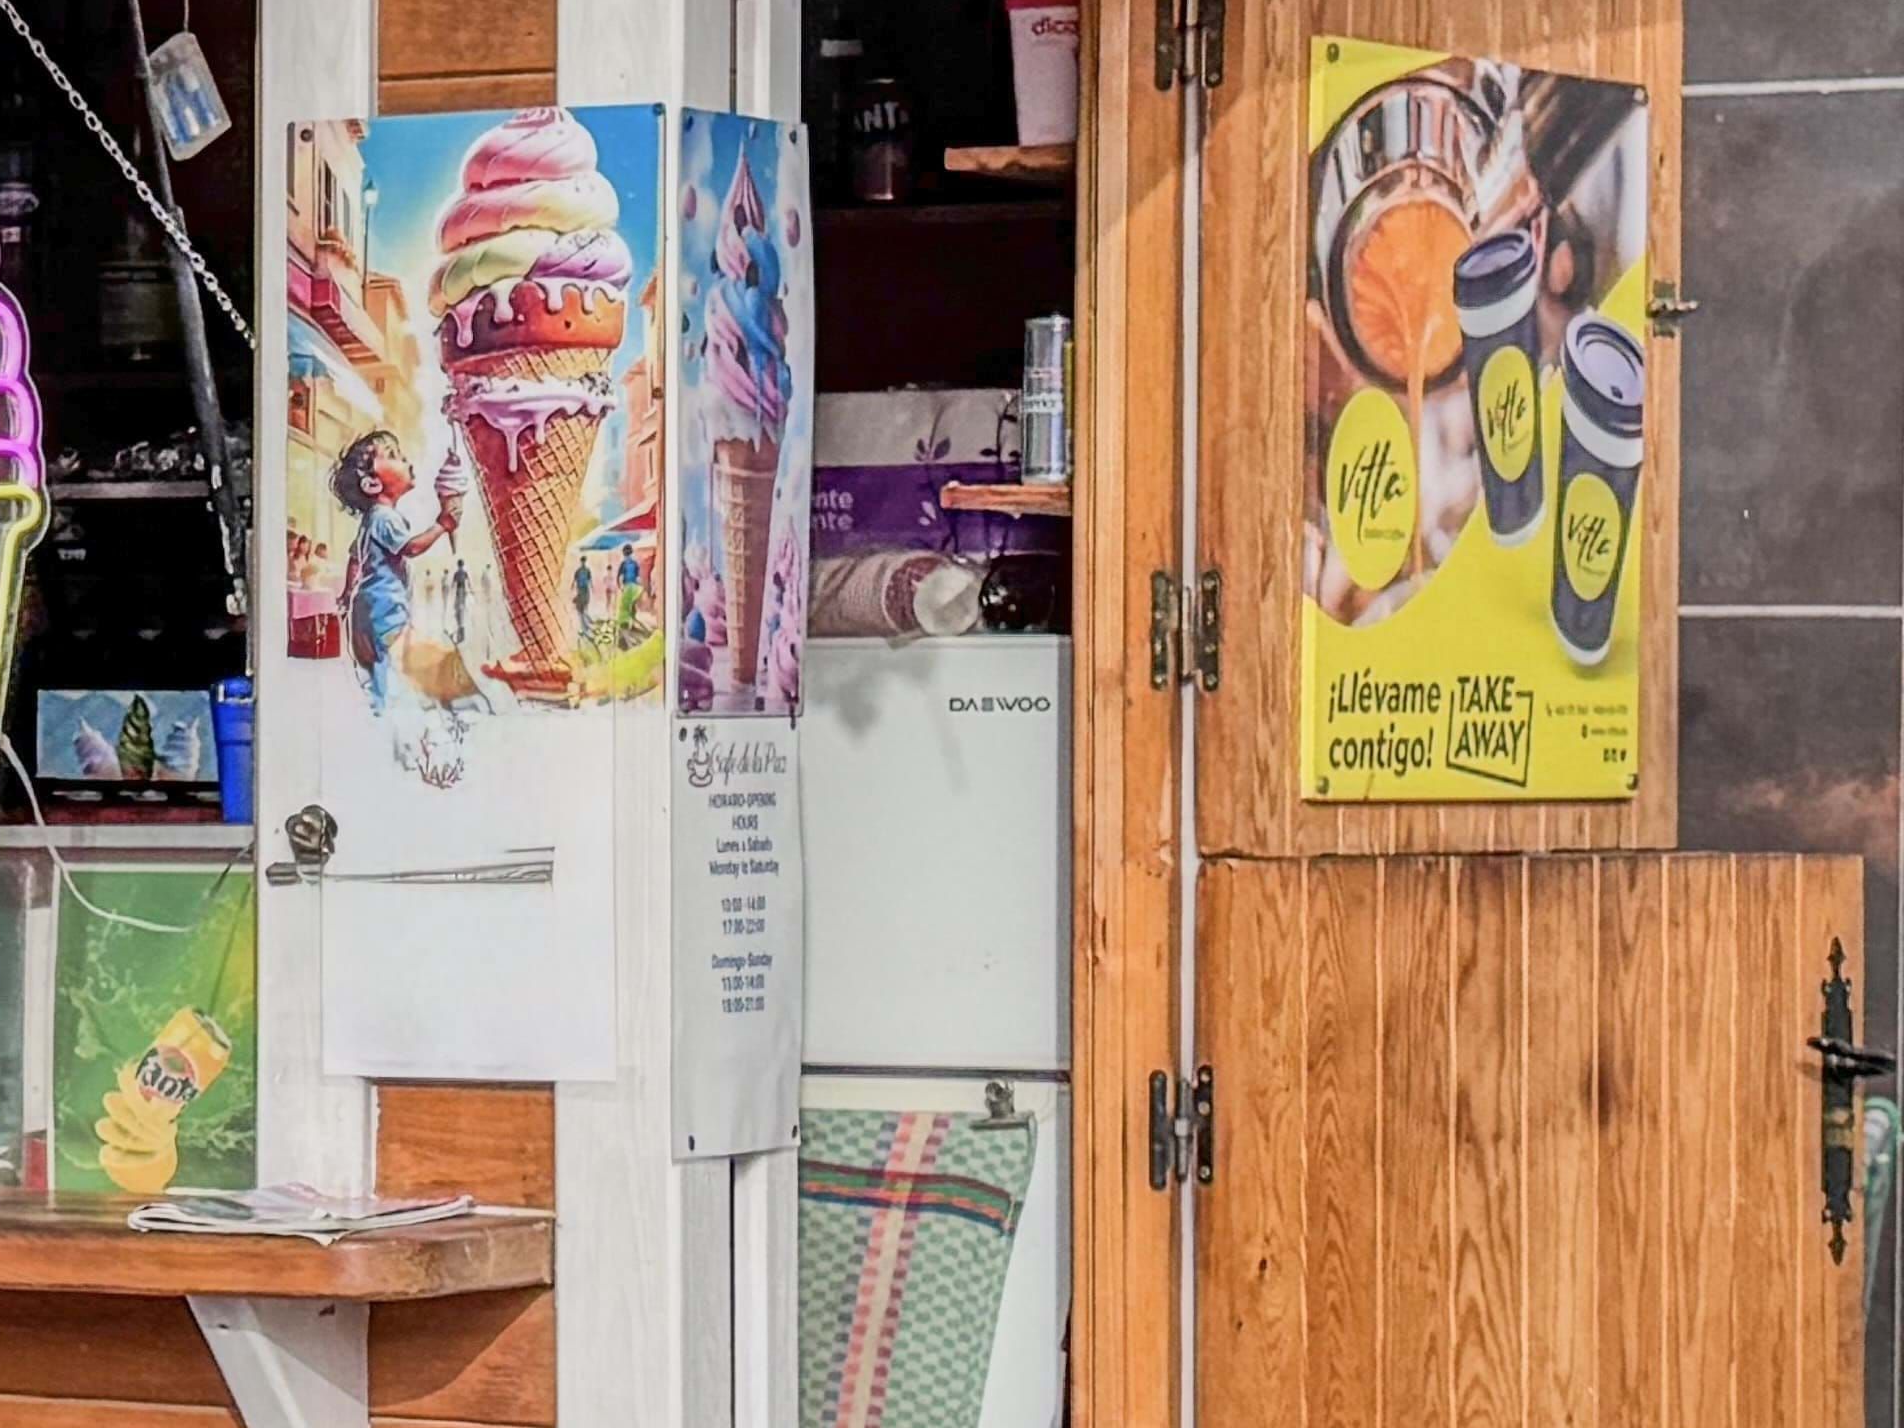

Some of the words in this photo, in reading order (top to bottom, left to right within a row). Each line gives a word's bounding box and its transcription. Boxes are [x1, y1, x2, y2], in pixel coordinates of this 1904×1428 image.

[1328, 667, 1441, 723] ¡Llévame
[1457, 676, 1515, 713] TAKE
[1329, 723, 1433, 776] contigo!
[1455, 720, 1526, 765] AWAY
